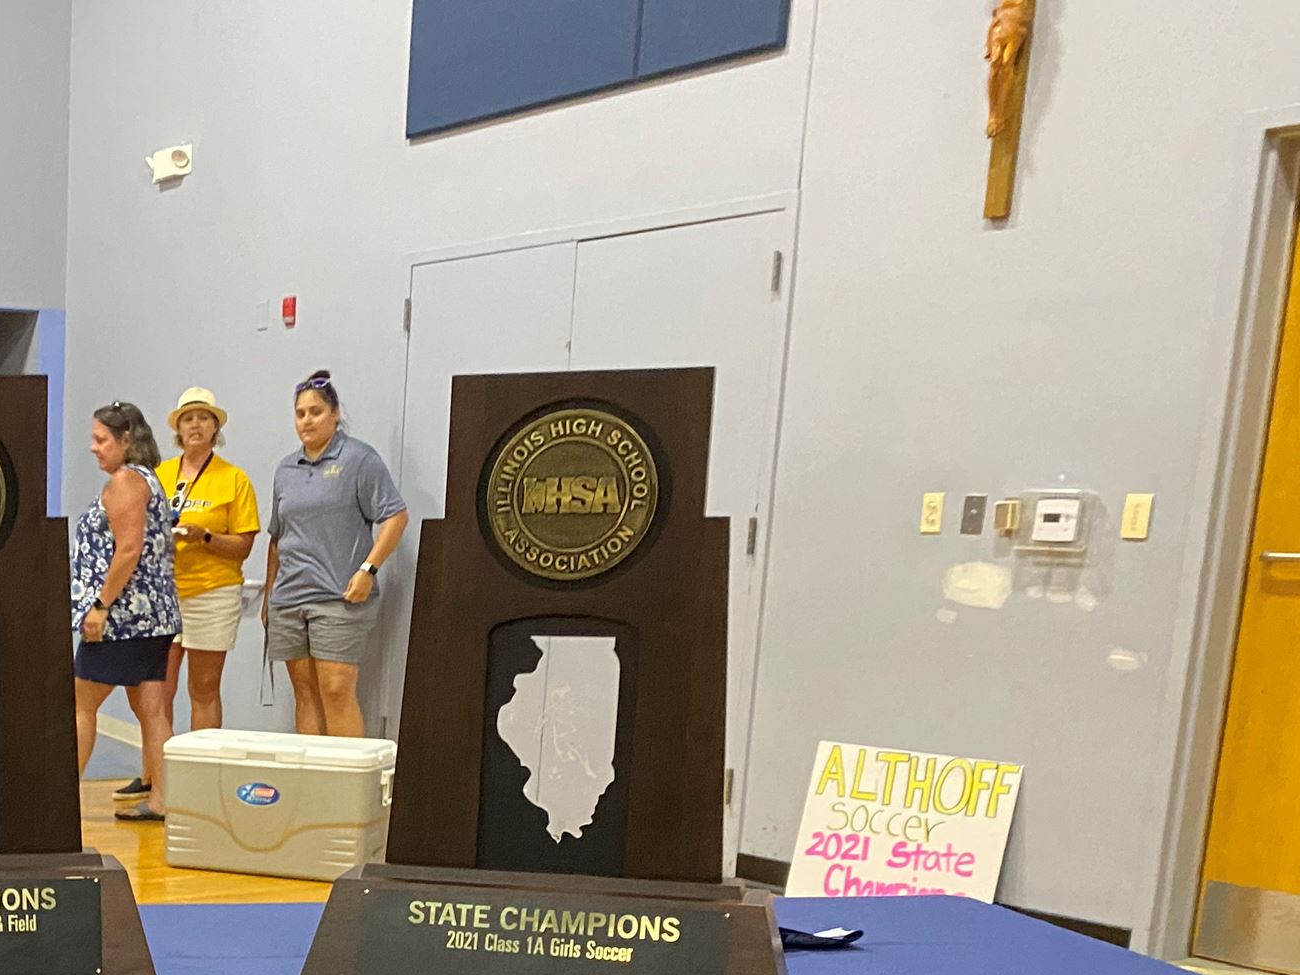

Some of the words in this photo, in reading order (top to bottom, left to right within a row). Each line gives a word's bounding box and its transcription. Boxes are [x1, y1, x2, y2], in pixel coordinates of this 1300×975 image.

[496, 429, 545, 513] ILLINOIS
[550, 418, 603, 438] HIGH
[606, 429, 649, 512] SCHOOL
[504, 525, 635, 571] ASSOCIATION
[815, 745, 1021, 818] ALTHOFF
[805, 831, 870, 861] 2021
[886, 840, 975, 878] State
[8, 914, 37, 932] Field
[408, 900, 491, 929] STATE
[499, 906, 681, 943] CHAMPIONS
[446, 930, 479, 951] 2021
[484, 933, 520, 954] Class
[526, 936, 545, 956] 1A
[550, 938, 581, 959] Girls
[585, 940, 634, 964] Soccer
